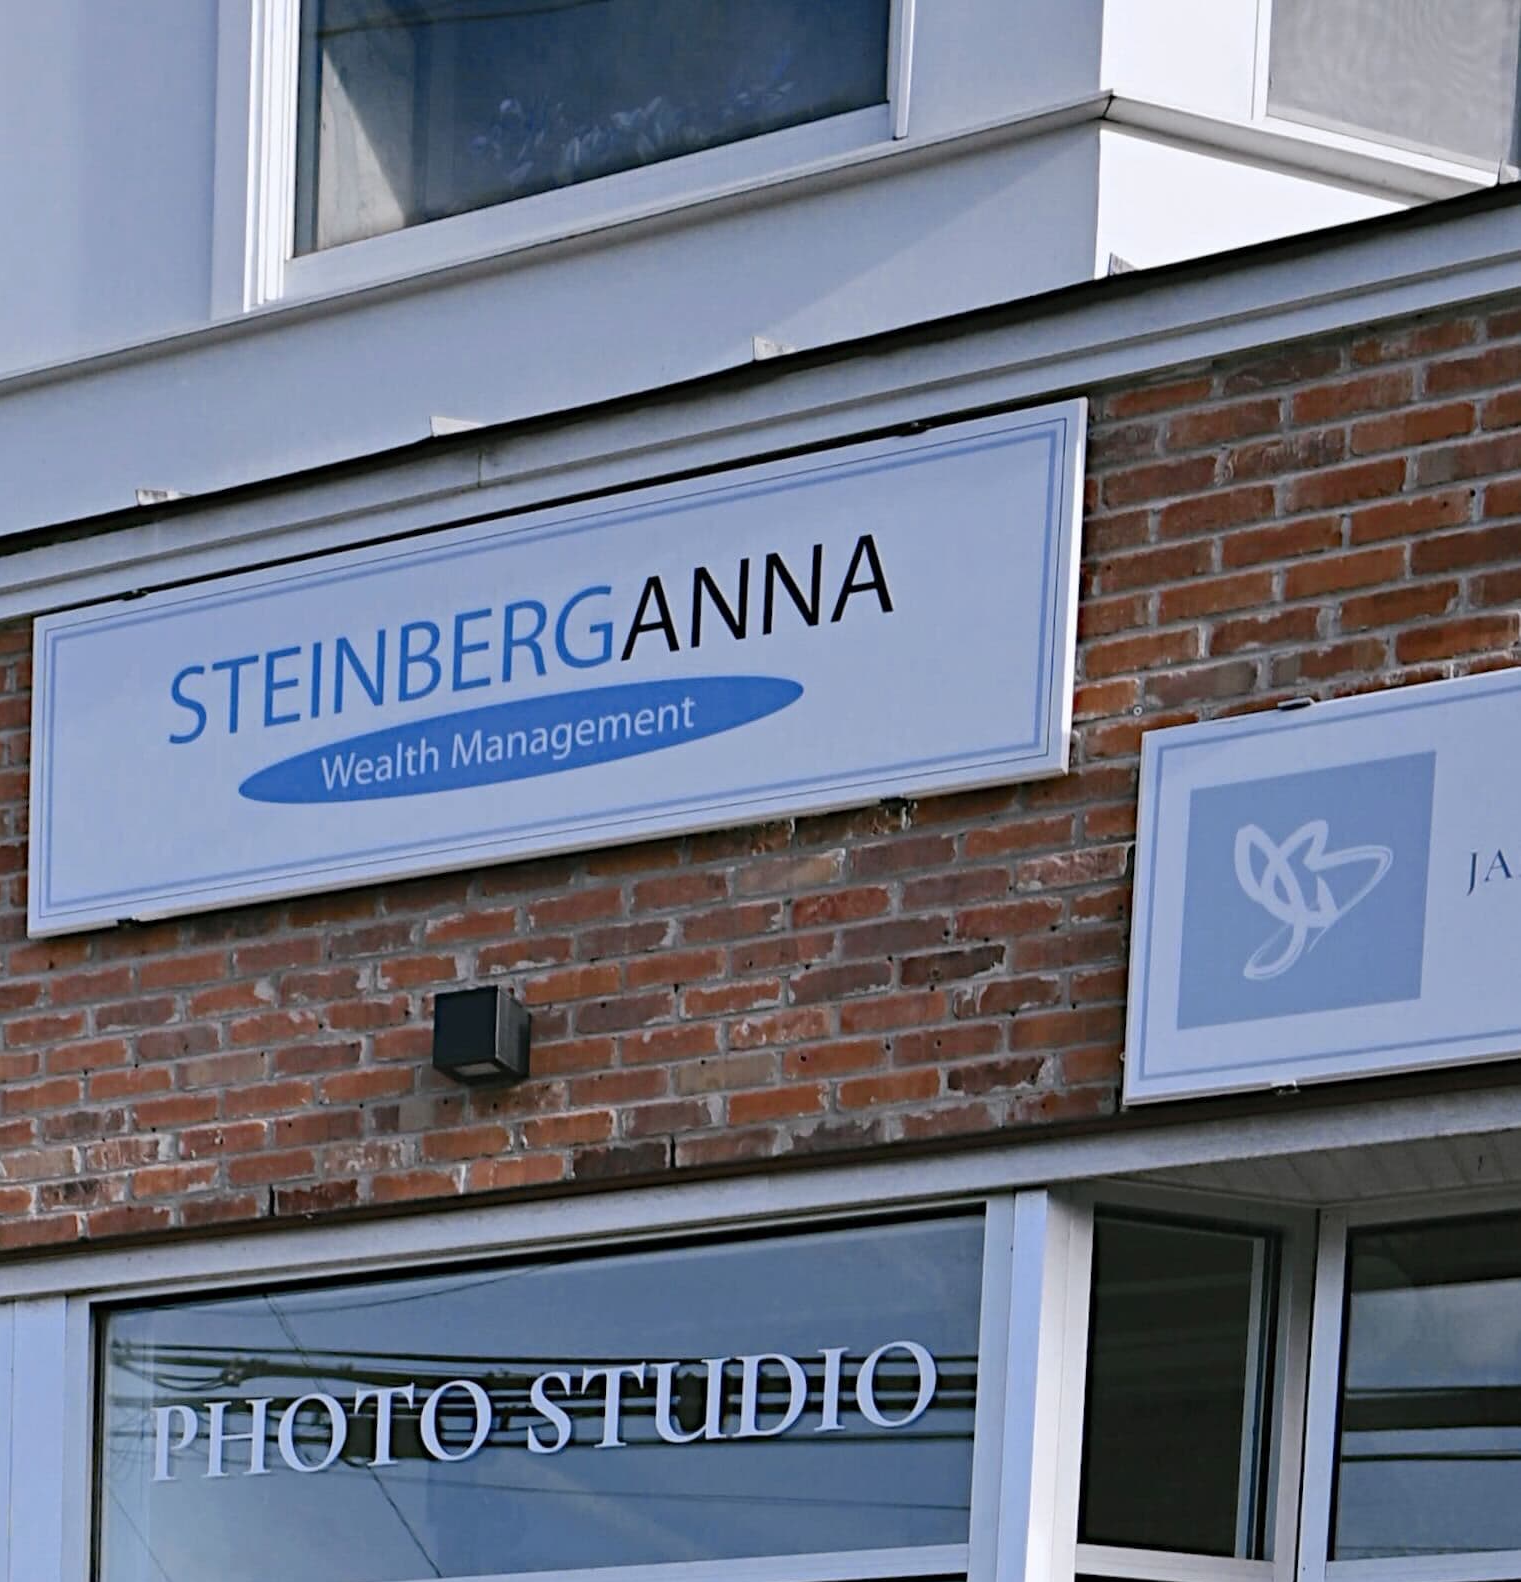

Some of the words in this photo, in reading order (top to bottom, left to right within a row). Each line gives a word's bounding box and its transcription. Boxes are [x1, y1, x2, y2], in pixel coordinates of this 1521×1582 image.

[168, 533, 895, 745] STEINBERGANNA
[321, 743, 440, 790] Wealth
[450, 696, 696, 767] Management
[1466, 848, 1521, 896] JA
[153, 1380, 492, 1481] PHOTO
[527, 1340, 937, 1454] STUDIO
